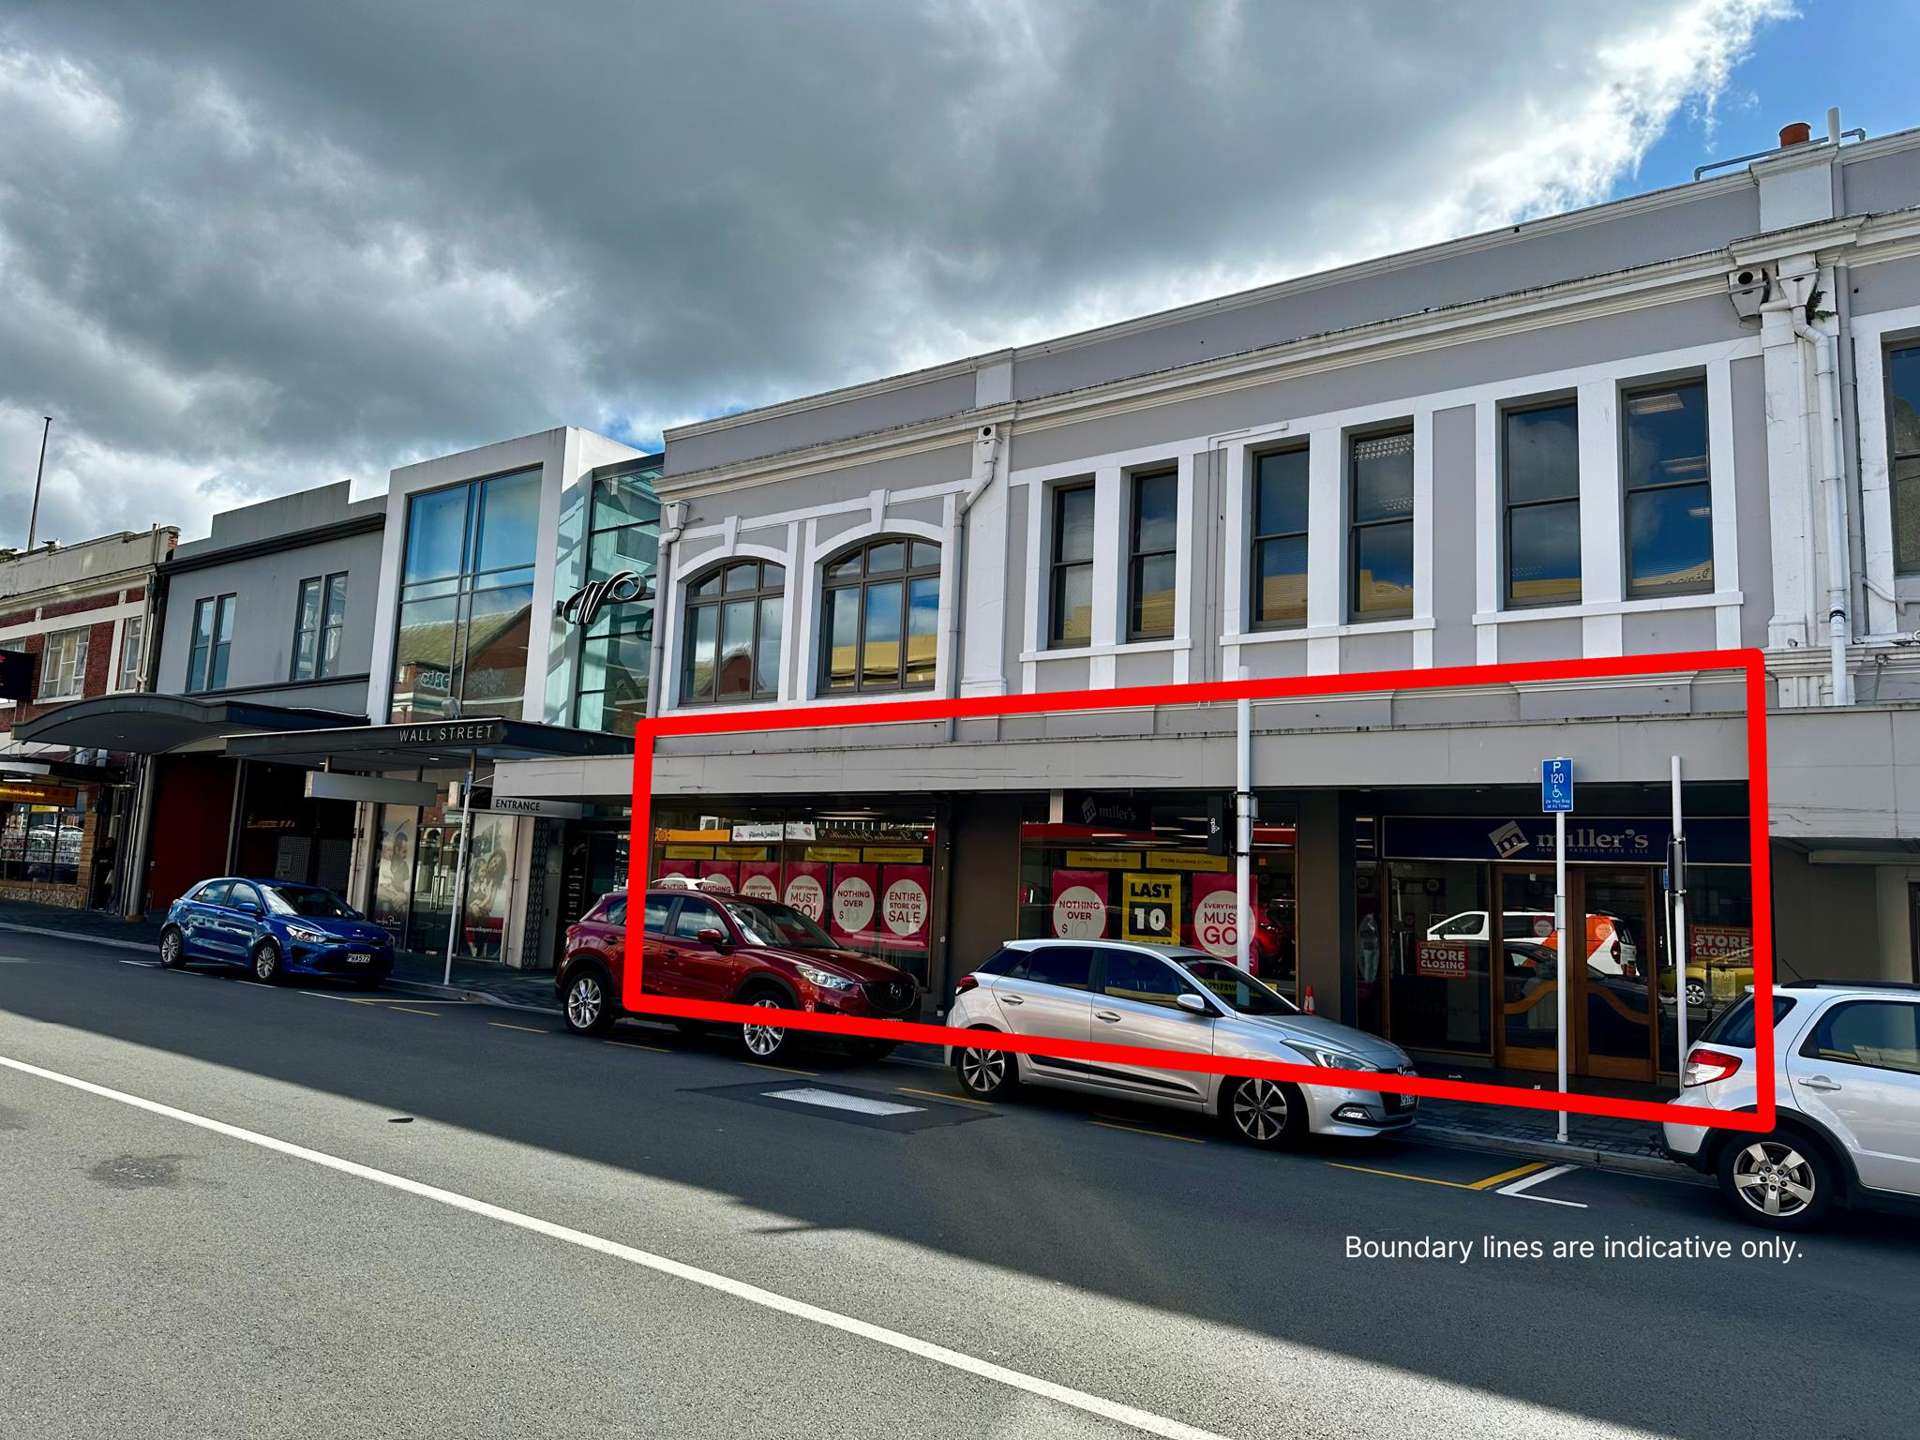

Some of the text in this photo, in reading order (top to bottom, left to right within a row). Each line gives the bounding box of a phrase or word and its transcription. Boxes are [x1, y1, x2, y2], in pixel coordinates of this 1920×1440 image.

[400, 725, 493, 742] WALL STREET
[1553, 761, 1561, 773] P
[1551, 773, 1564, 784] 120
[495, 799, 540, 811] ENTRANCE
[837, 890, 870, 898] NOTHING
[889, 892, 921, 901] ENTIRE
[1130, 883, 1172, 898] LAST
[790, 893, 818, 903] MUST
[843, 900, 863, 908] OVER
[1059, 901, 1100, 910] NOTHING
[888, 911, 920, 923] SALE
[1067, 911, 1092, 920] OVER
[1134, 908, 1166, 931] 10
[1204, 912, 1237, 924] MUS
[1696, 934, 1750, 947] STORE
[1421, 949, 1464, 961] STORE
[1421, 960, 1465, 970] CLOSING
